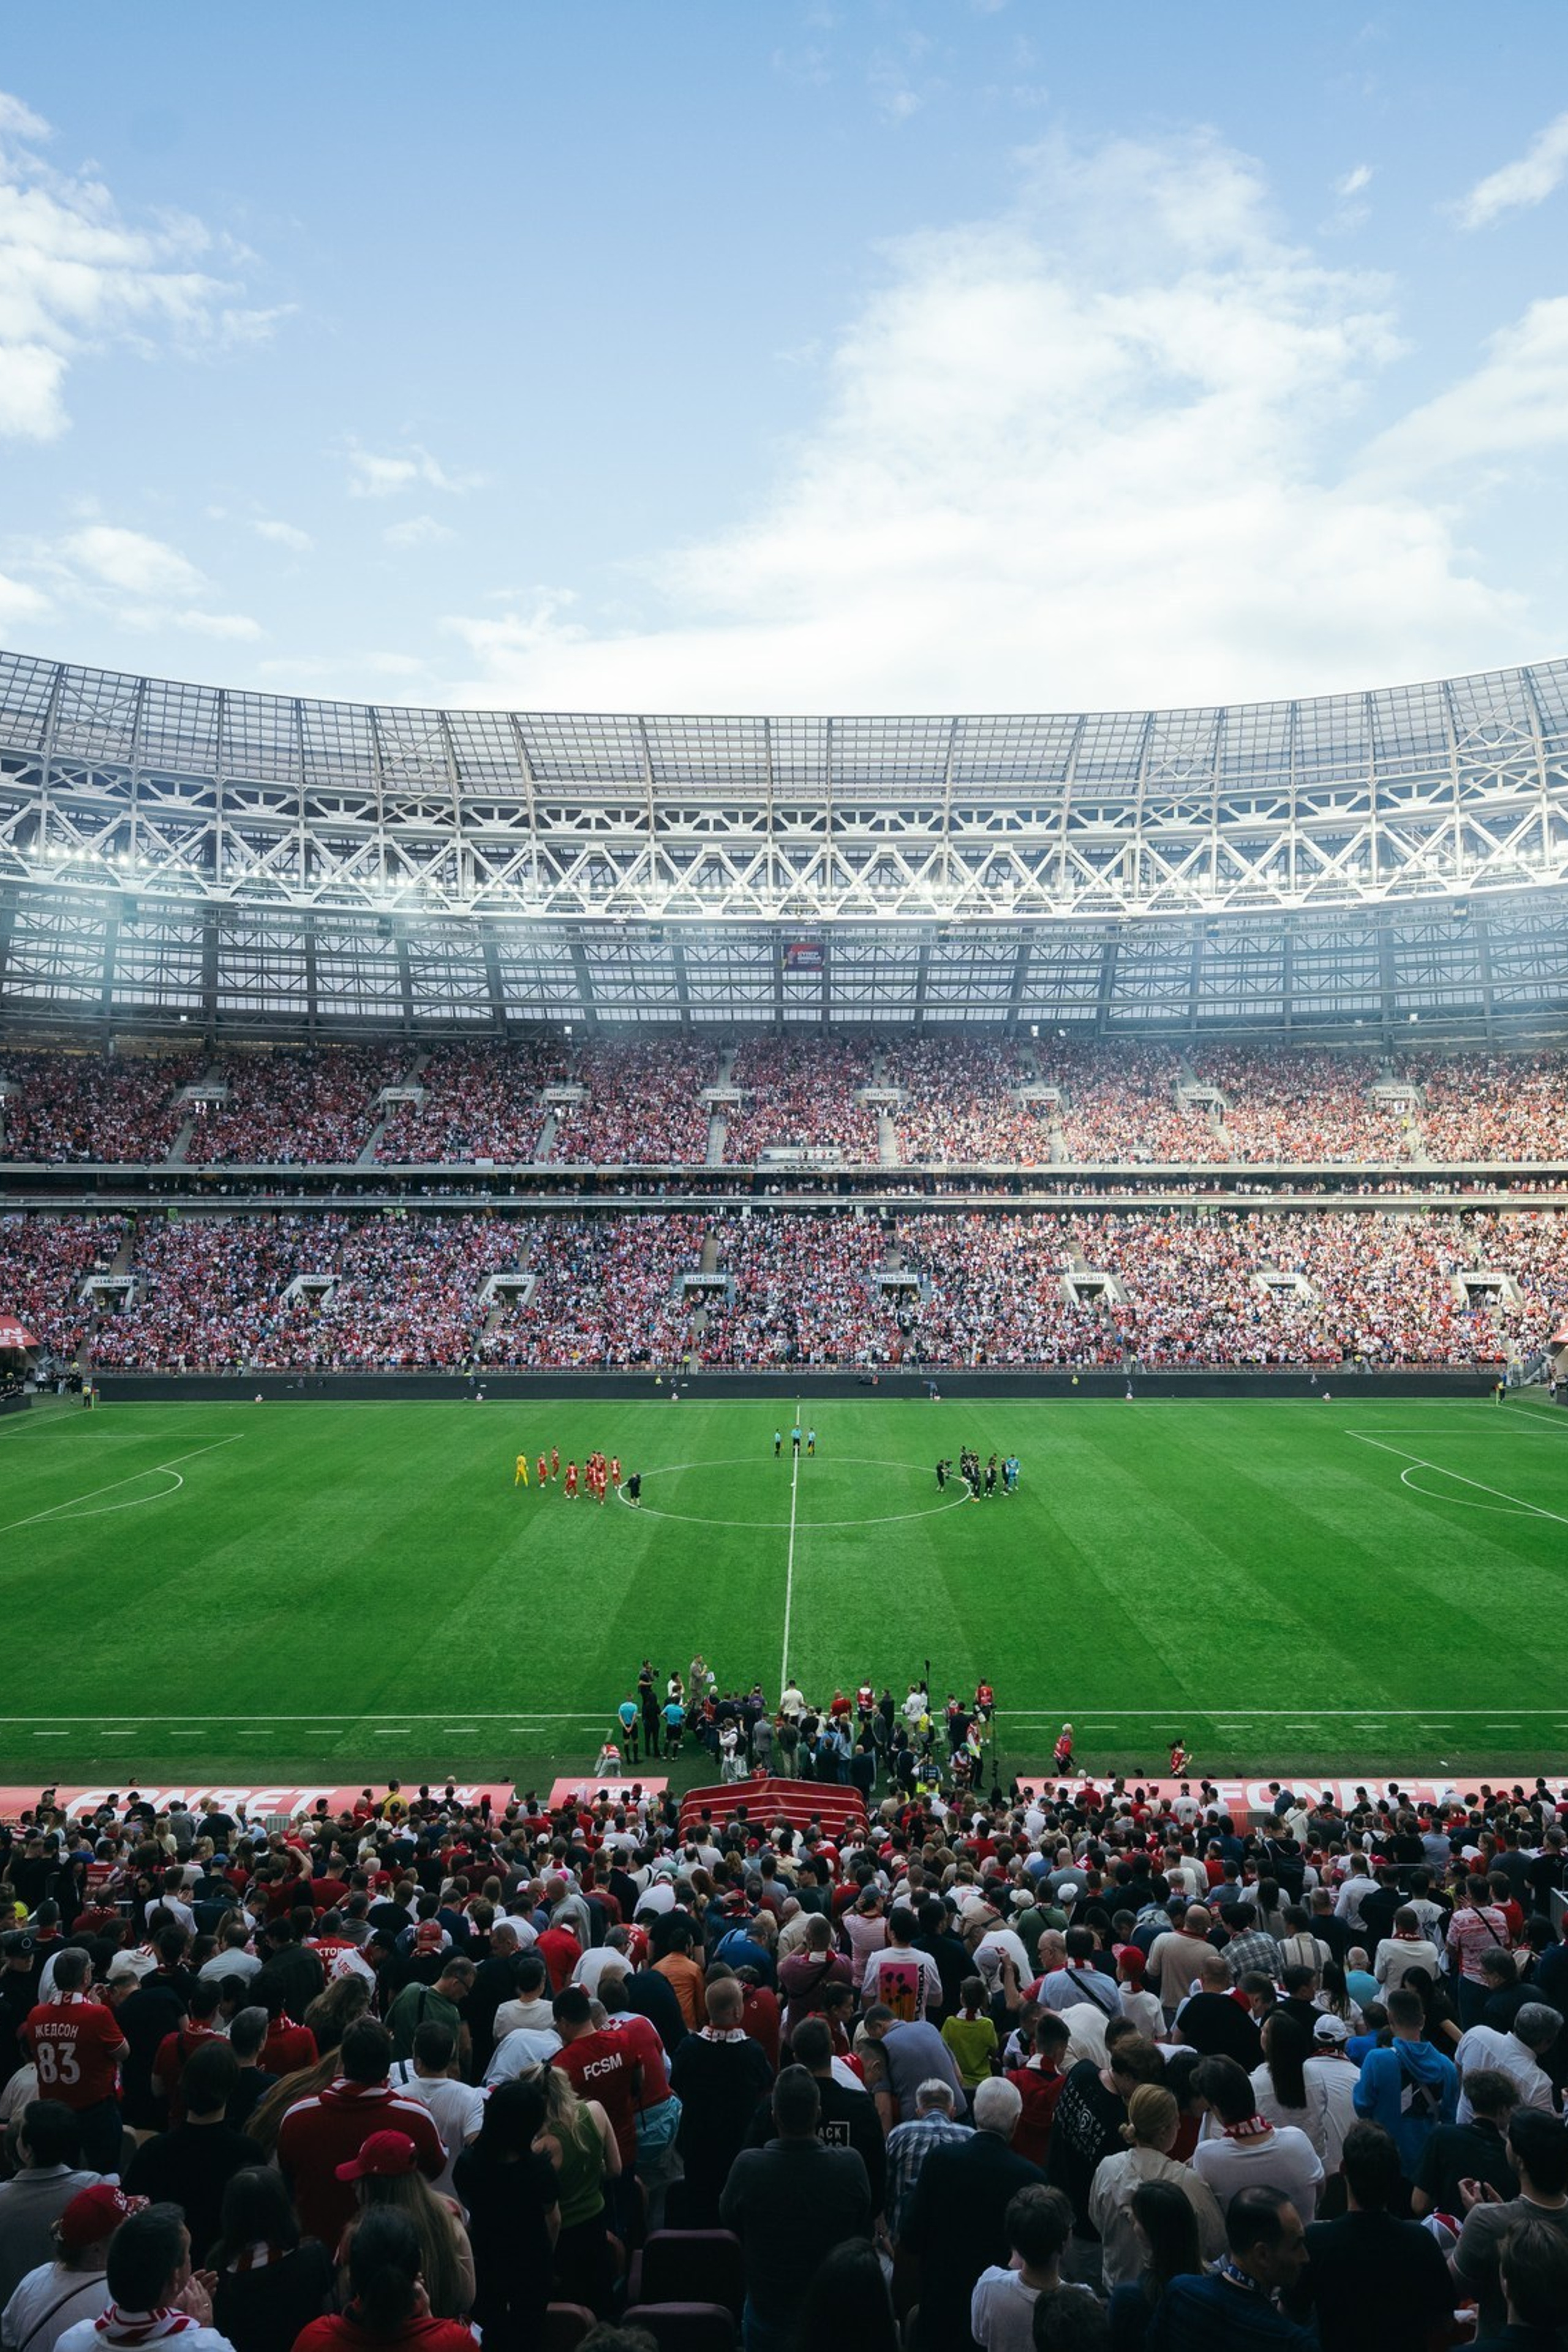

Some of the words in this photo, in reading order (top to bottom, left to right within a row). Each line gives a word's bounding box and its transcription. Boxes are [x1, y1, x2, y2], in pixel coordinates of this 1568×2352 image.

[65, 1789, 337, 1819] FONBET
[1212, 1781, 1457, 1811] FONBET
[34, 2022, 79, 2038] ЖЕДСОН
[37, 2041, 80, 2084] 83
[582, 2052, 622, 2081] FCSM
[818, 2127, 842, 2139] ACK
